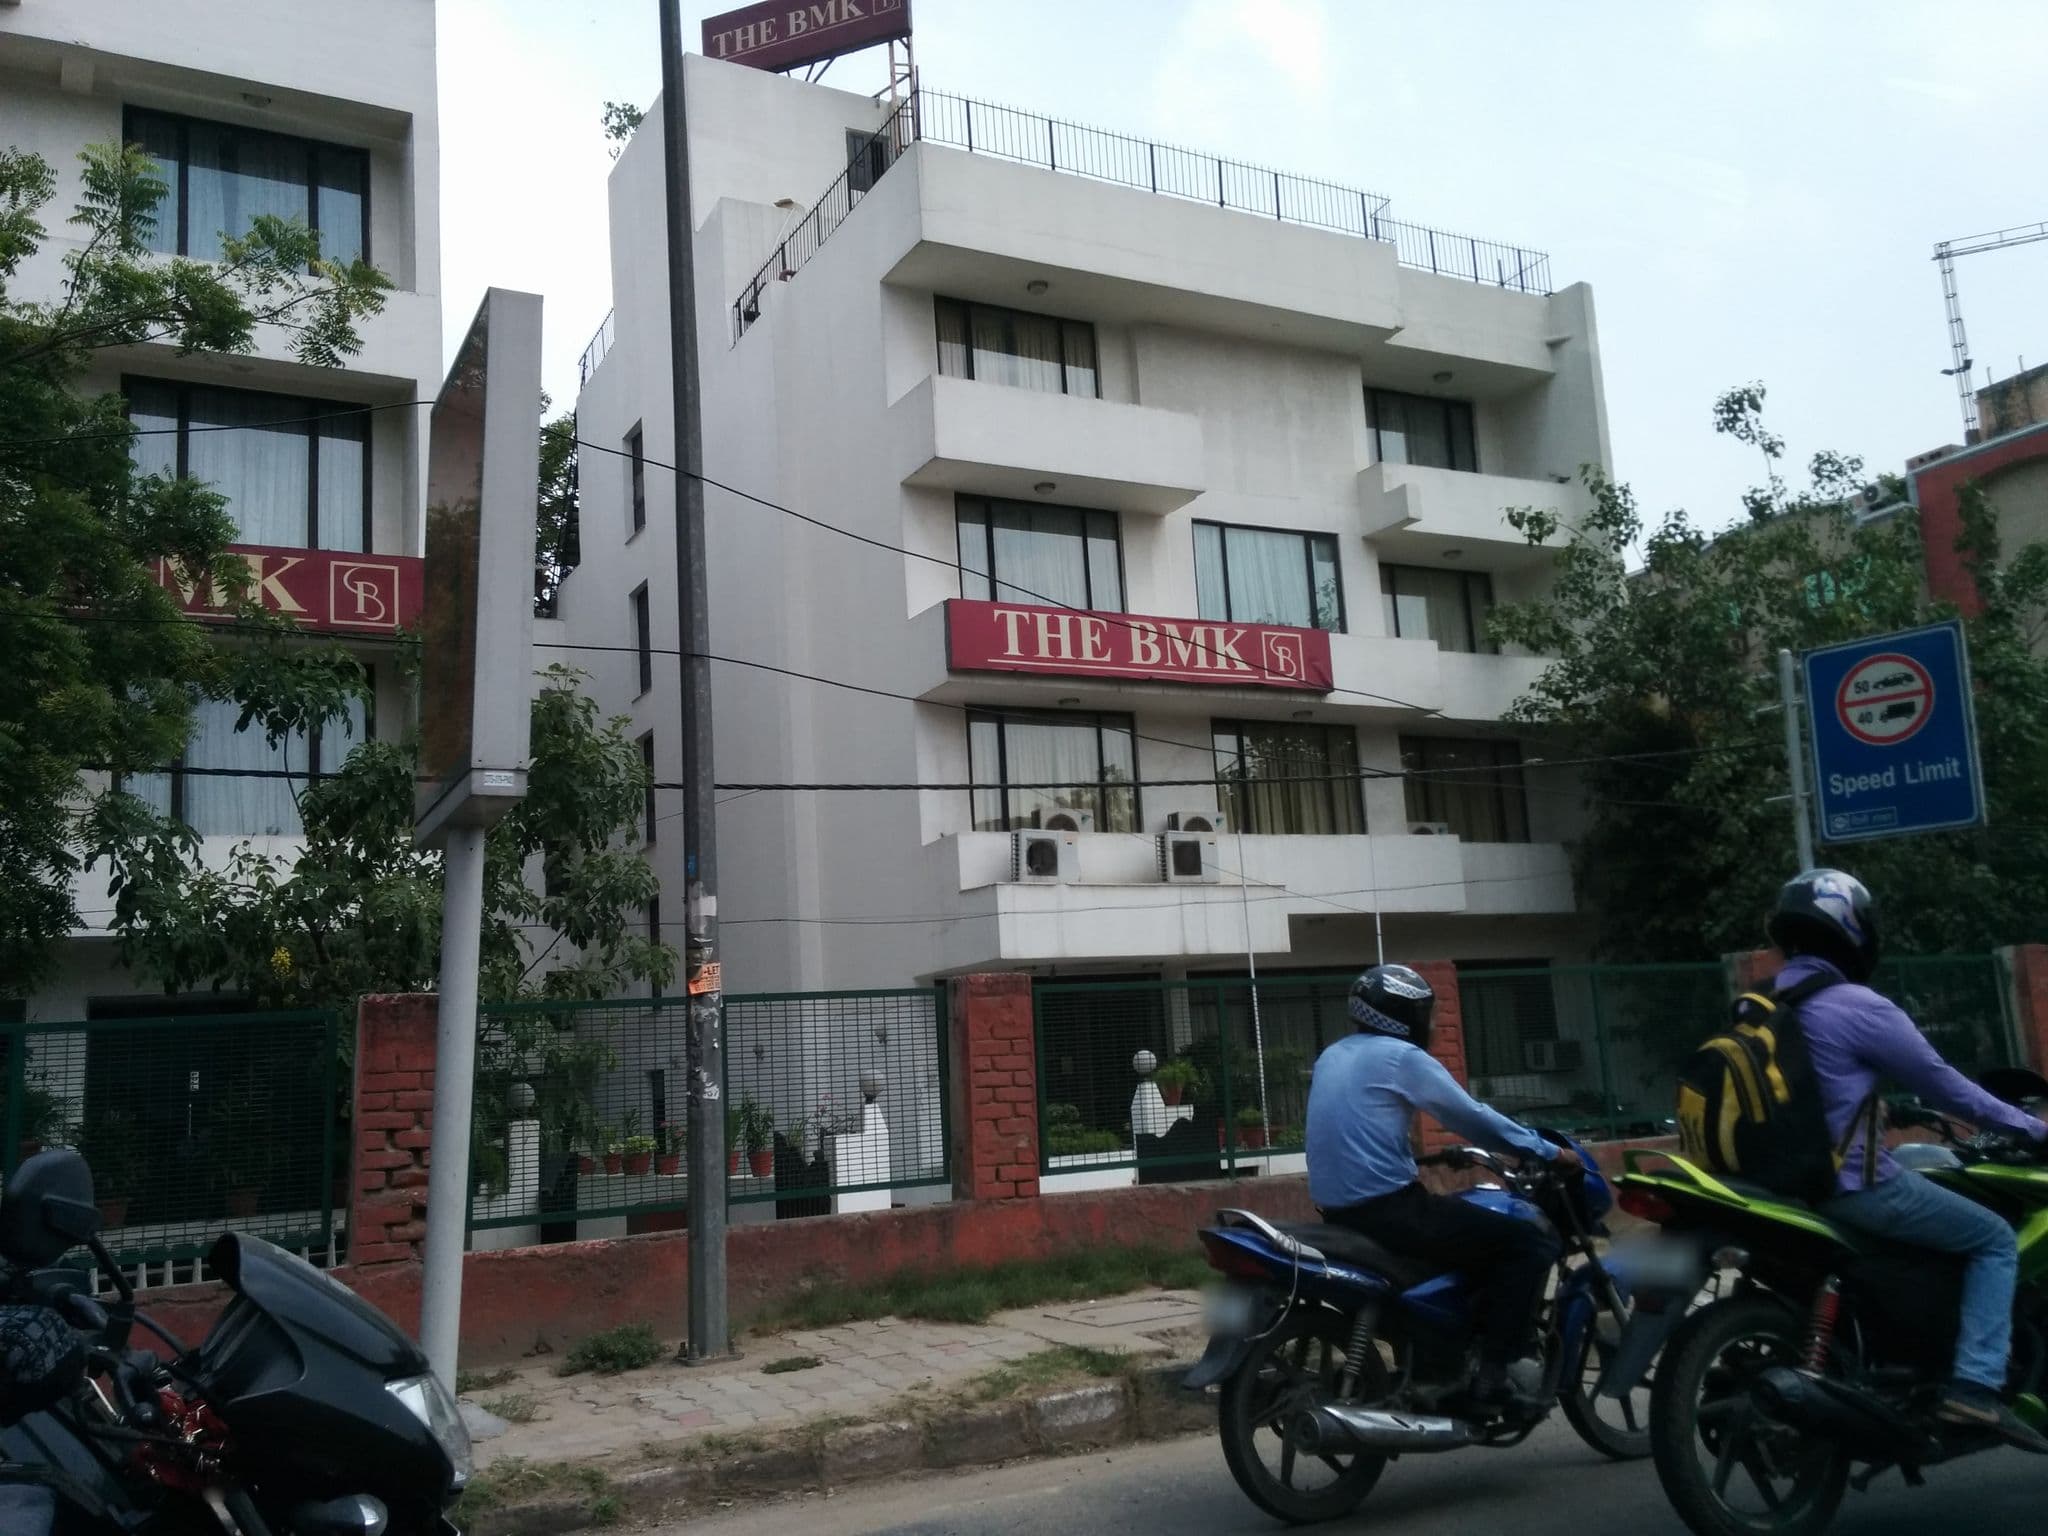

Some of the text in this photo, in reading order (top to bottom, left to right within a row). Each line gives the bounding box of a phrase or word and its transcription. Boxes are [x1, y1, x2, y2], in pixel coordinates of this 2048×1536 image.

[712, 0, 865, 58] THE BMK
[993, 609, 1112, 663] THE
[1126, 620, 1253, 672] BMK
[1853, 680, 1870, 694] 50
[1857, 711, 1873, 724] 40
[1829, 756, 1961, 799] Speed Limit
